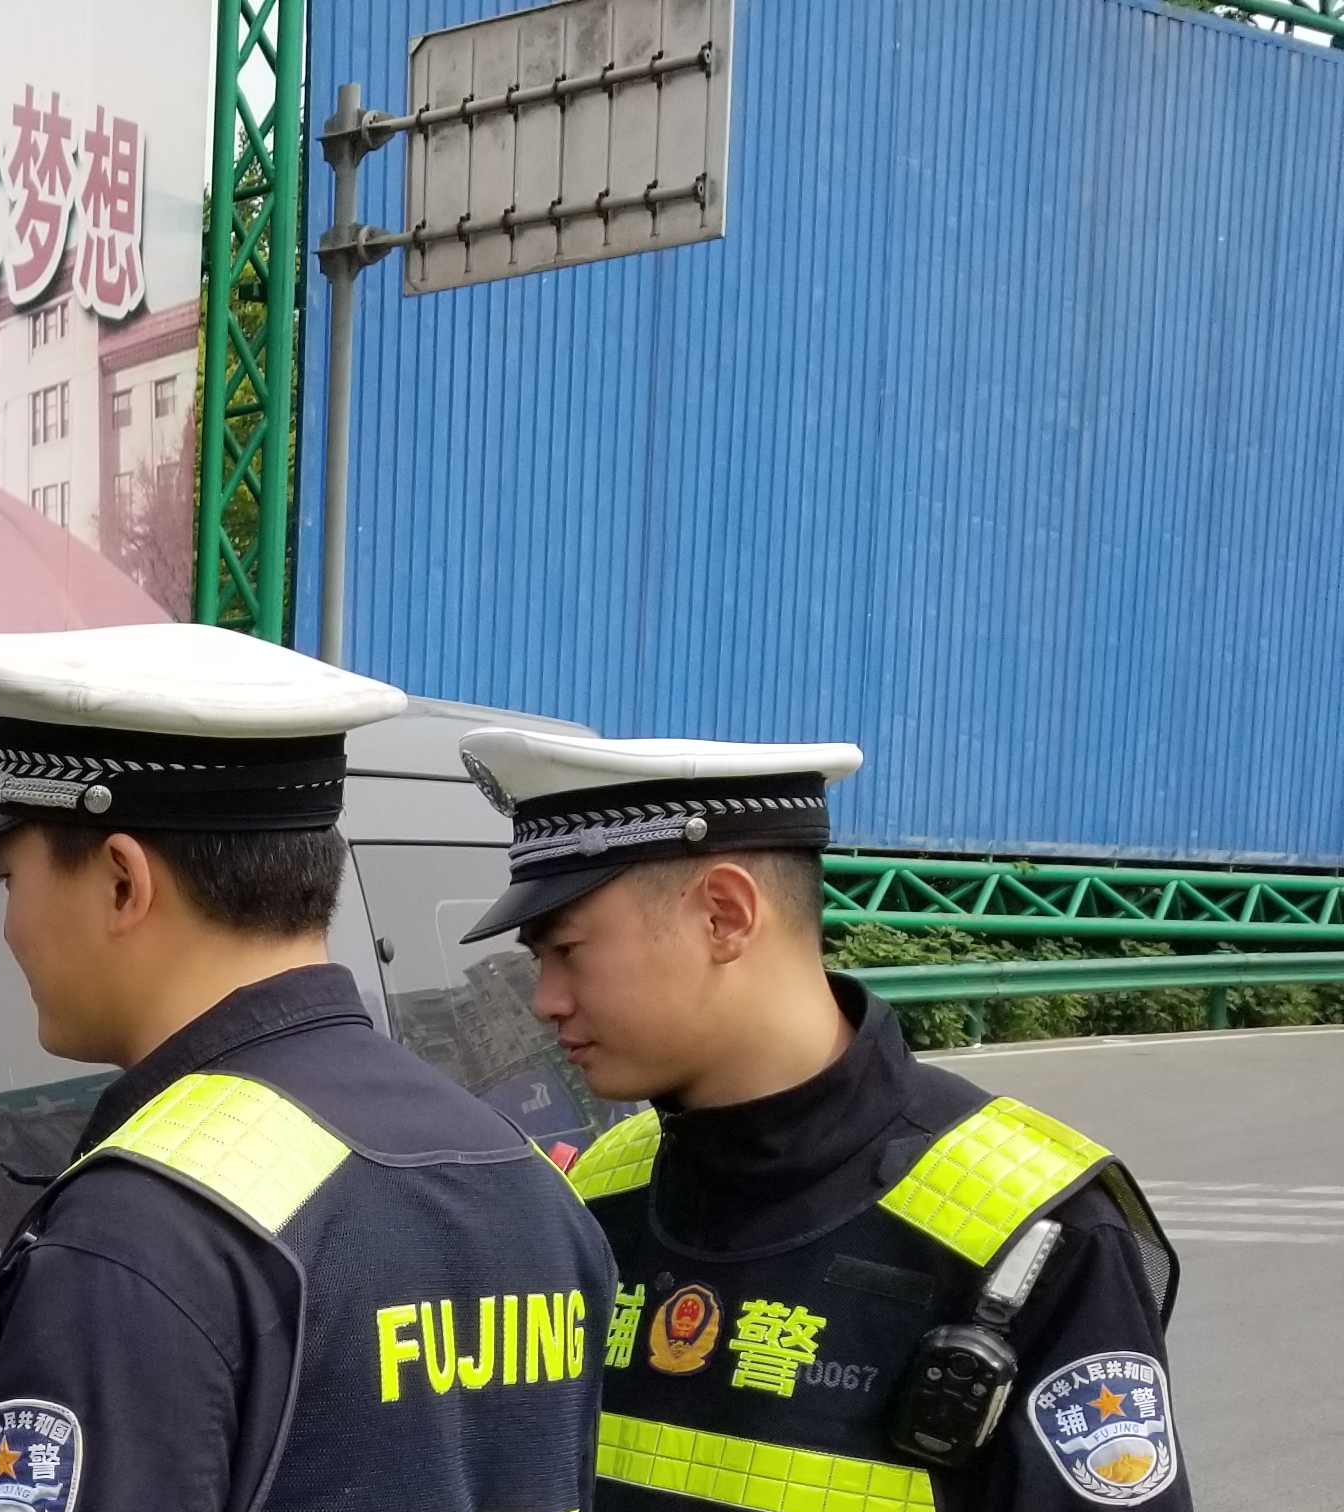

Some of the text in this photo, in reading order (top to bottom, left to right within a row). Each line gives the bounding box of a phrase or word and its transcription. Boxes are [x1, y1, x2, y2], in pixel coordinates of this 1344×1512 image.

[376, 1288, 586, 1403] FUJING
[793, 1359, 880, 1394] 0067
[1036, 1360, 1155, 1410] 中华人民共和国
